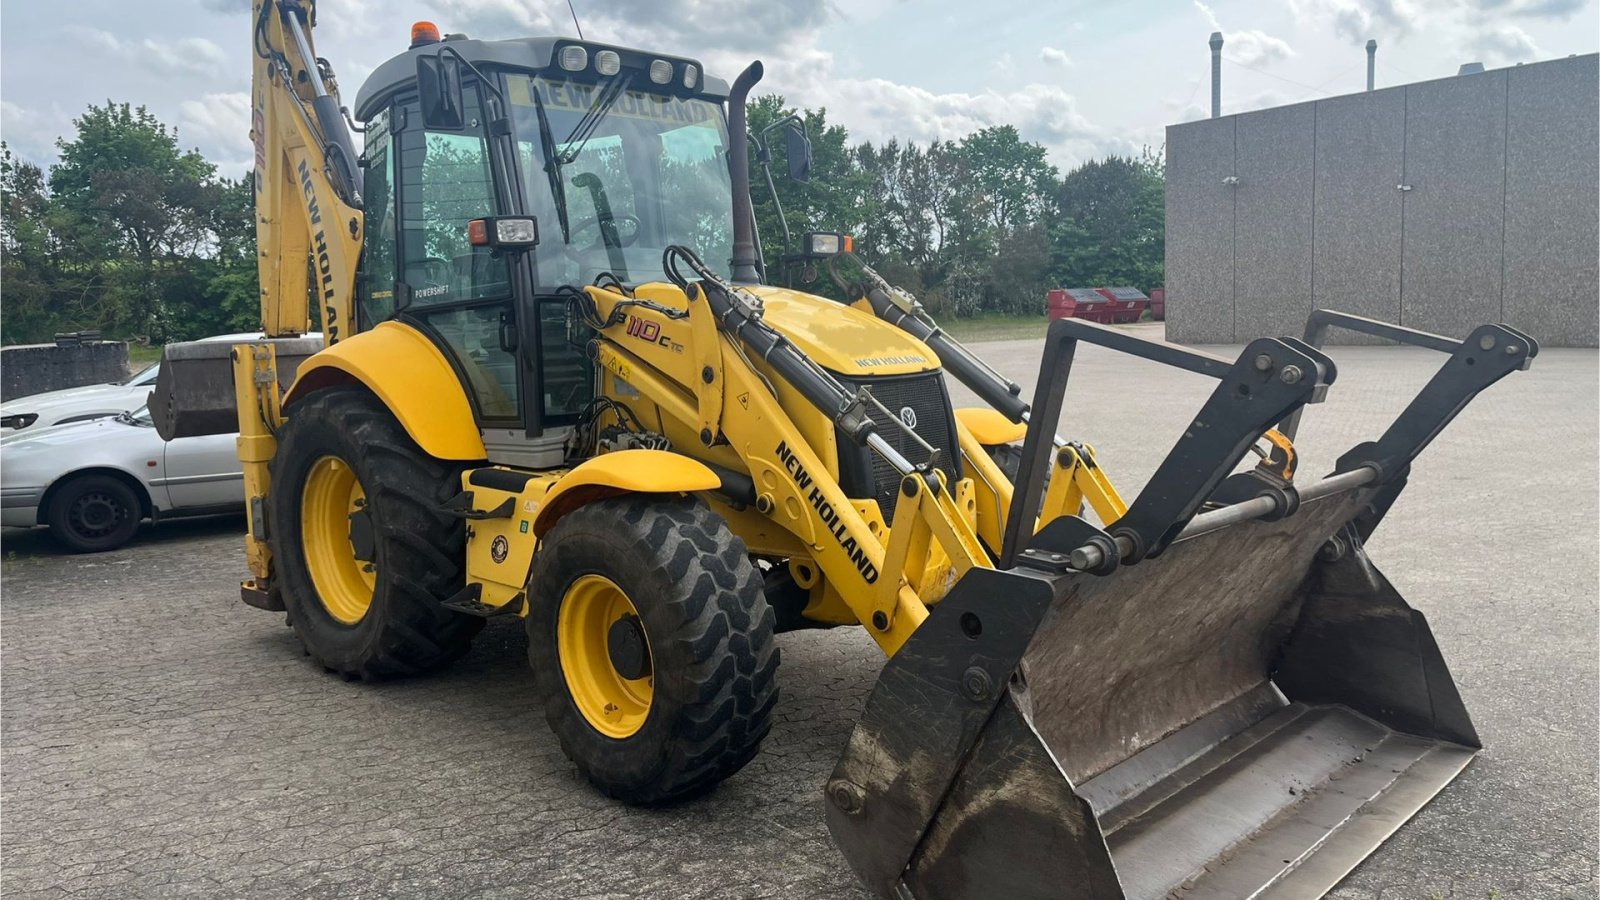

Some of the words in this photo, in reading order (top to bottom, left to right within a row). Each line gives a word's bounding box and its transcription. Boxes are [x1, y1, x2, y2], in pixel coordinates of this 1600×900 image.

[527, 77, 592, 109] NEW
[298, 158, 321, 225] NEW
[315, 229, 339, 346] HOLLAN
[415, 285, 449, 298] POWERSHIFT
[626, 315, 660, 343] 110
[855, 358, 881, 368] NEW
[775, 440, 812, 490] NEW
[808, 487, 879, 585] HOLLAND
